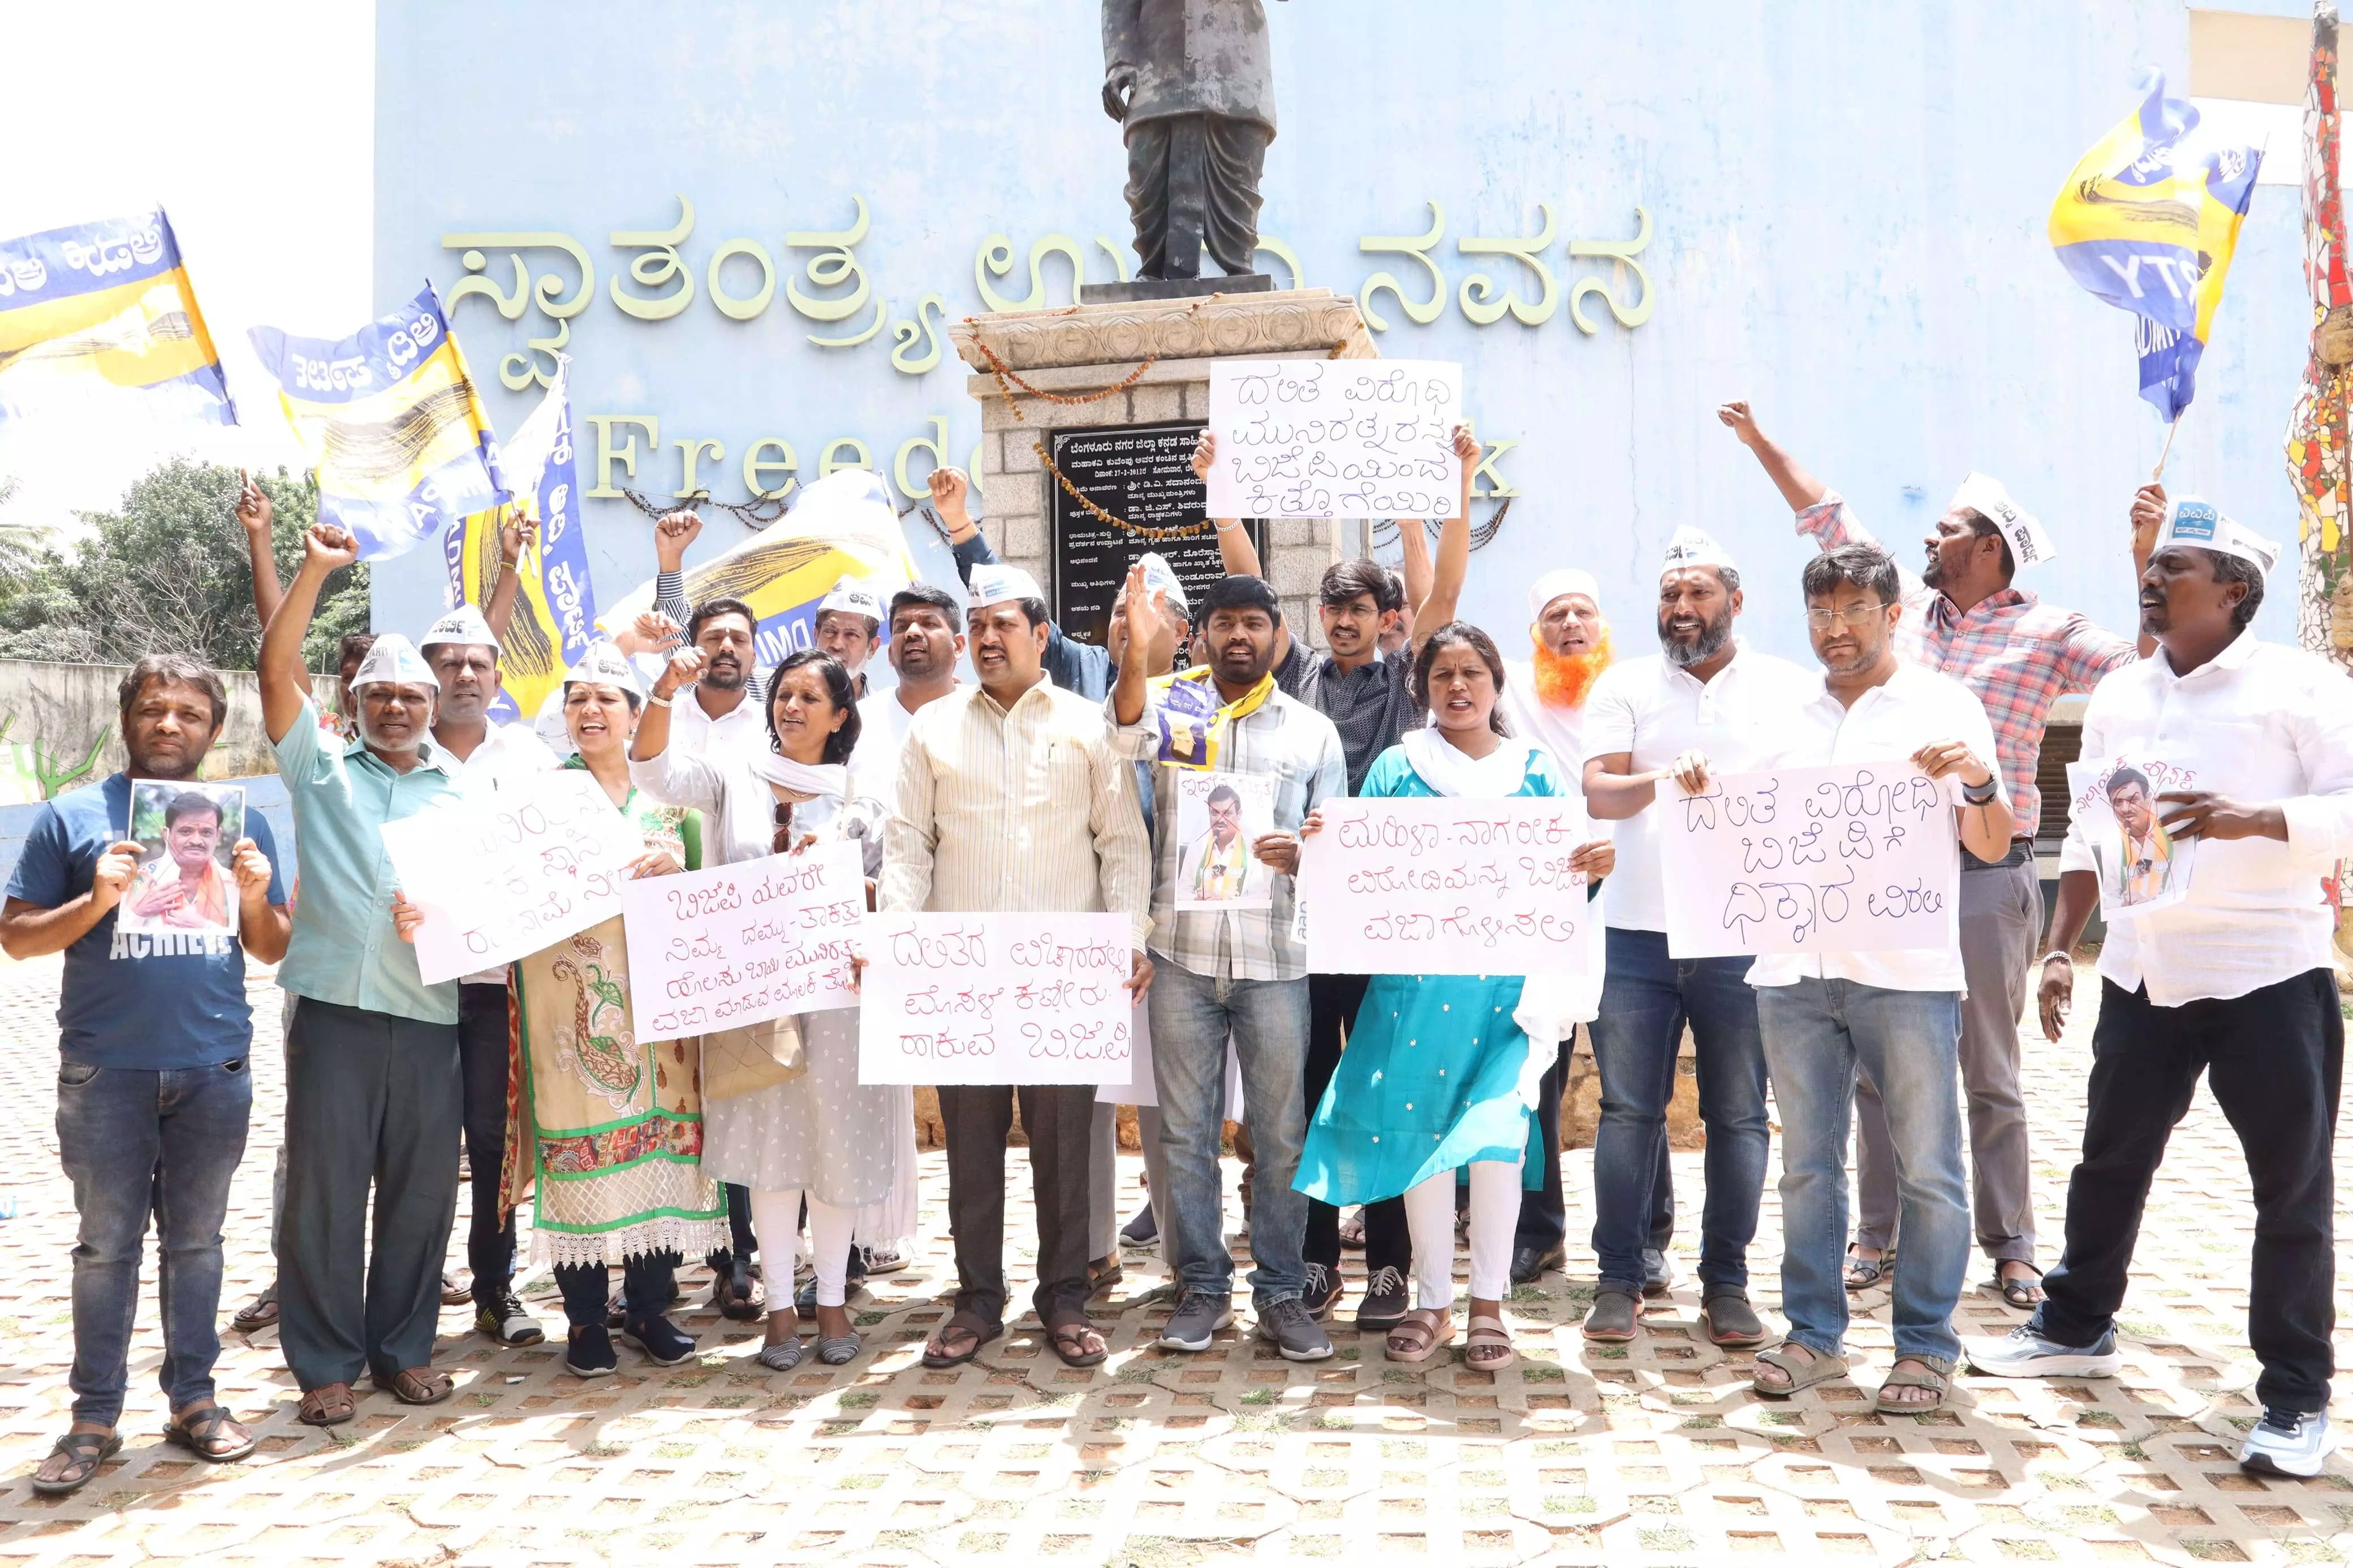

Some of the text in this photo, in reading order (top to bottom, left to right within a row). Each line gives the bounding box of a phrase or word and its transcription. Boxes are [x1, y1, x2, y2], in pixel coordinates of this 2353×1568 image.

[442, 193, 945, 391] ಸ್ವಾತಂತ್ರ್ಯ
[1231, 362, 1324, 404] ದಲಿತ
[585, 414, 982, 500] Freed
[1071, 443, 1113, 454] ಬೆಂಗಳೂರು
[1115, 439, 1134, 451] ನಗರ
[1158, 436, 1177, 453] ಕನ್ನಡ
[1180, 435, 1198, 446] ಸಾಹಿ
[1071, 460, 1103, 468] ಮಹಾಕವಿ
[1166, 478, 1204, 487] ಸದಾನಂದ
[1679, 770, 1938, 832] ದಲಿತ ವಿರೋಧಿ
